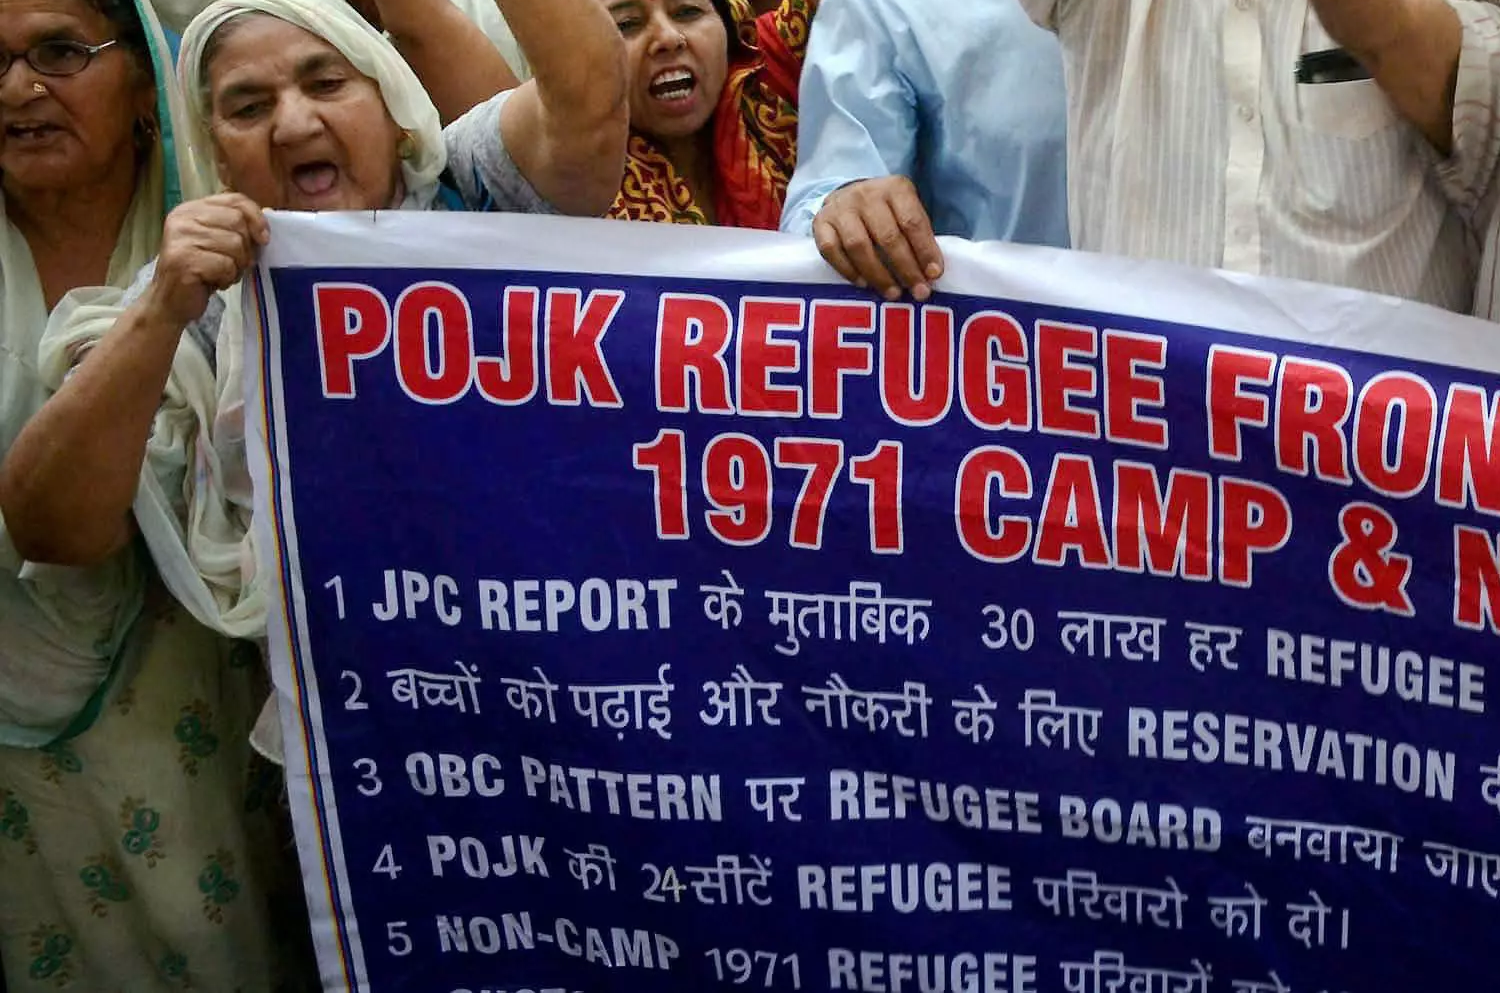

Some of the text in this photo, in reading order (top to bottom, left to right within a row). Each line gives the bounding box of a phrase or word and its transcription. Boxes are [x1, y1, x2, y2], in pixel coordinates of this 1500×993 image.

[313, 281, 625, 408] POJK
[655, 292, 1168, 449] REFUGEE
[633, 429, 903, 555] 1971
[954, 445, 1293, 588] CAMP
[1328, 502, 1416, 617] &
[324, 574, 345, 620] 1
[372, 569, 462, 626] JPC
[478, 577, 678, 632] REPORT
[699, 569, 745, 630] के
[764, 580, 933, 656] मुताबिक
[981, 604, 1035, 651] 30
[1057, 610, 1168, 662] लाख
[1184, 621, 1243, 672] हर
[1266, 628, 1485, 713] REFUGEE
[340, 670, 369, 711] 2
[386, 660, 482, 714] बच्चों
[567, 662, 675, 741] पढ़ाई
[699, 664, 784, 727] और
[801, 672, 933, 738] नौकरी
[951, 683, 998, 744] के
[1017, 688, 1104, 757] लिए
[1128, 706, 1456, 802] RESERVATION
[352, 757, 383, 797] 3
[405, 751, 505, 797] OBC
[521, 755, 722, 822] PATTERN
[744, 776, 806, 823] पर
[829, 769, 1042, 833] REFUGEE
[1059, 795, 1222, 851] BOARD
[1245, 815, 1401, 873] बनवाया
[372, 844, 403, 880] 4
[426, 834, 549, 879] POJK
[797, 862, 1013, 914] REFUGEE
[1210, 882, 1268, 939] को
[386, 921, 413, 956] 5
[436, 911, 679, 970] NON-CAMP
[705, 948, 801, 989] 1971
[827, 948, 1037, 993] REFUGEE
